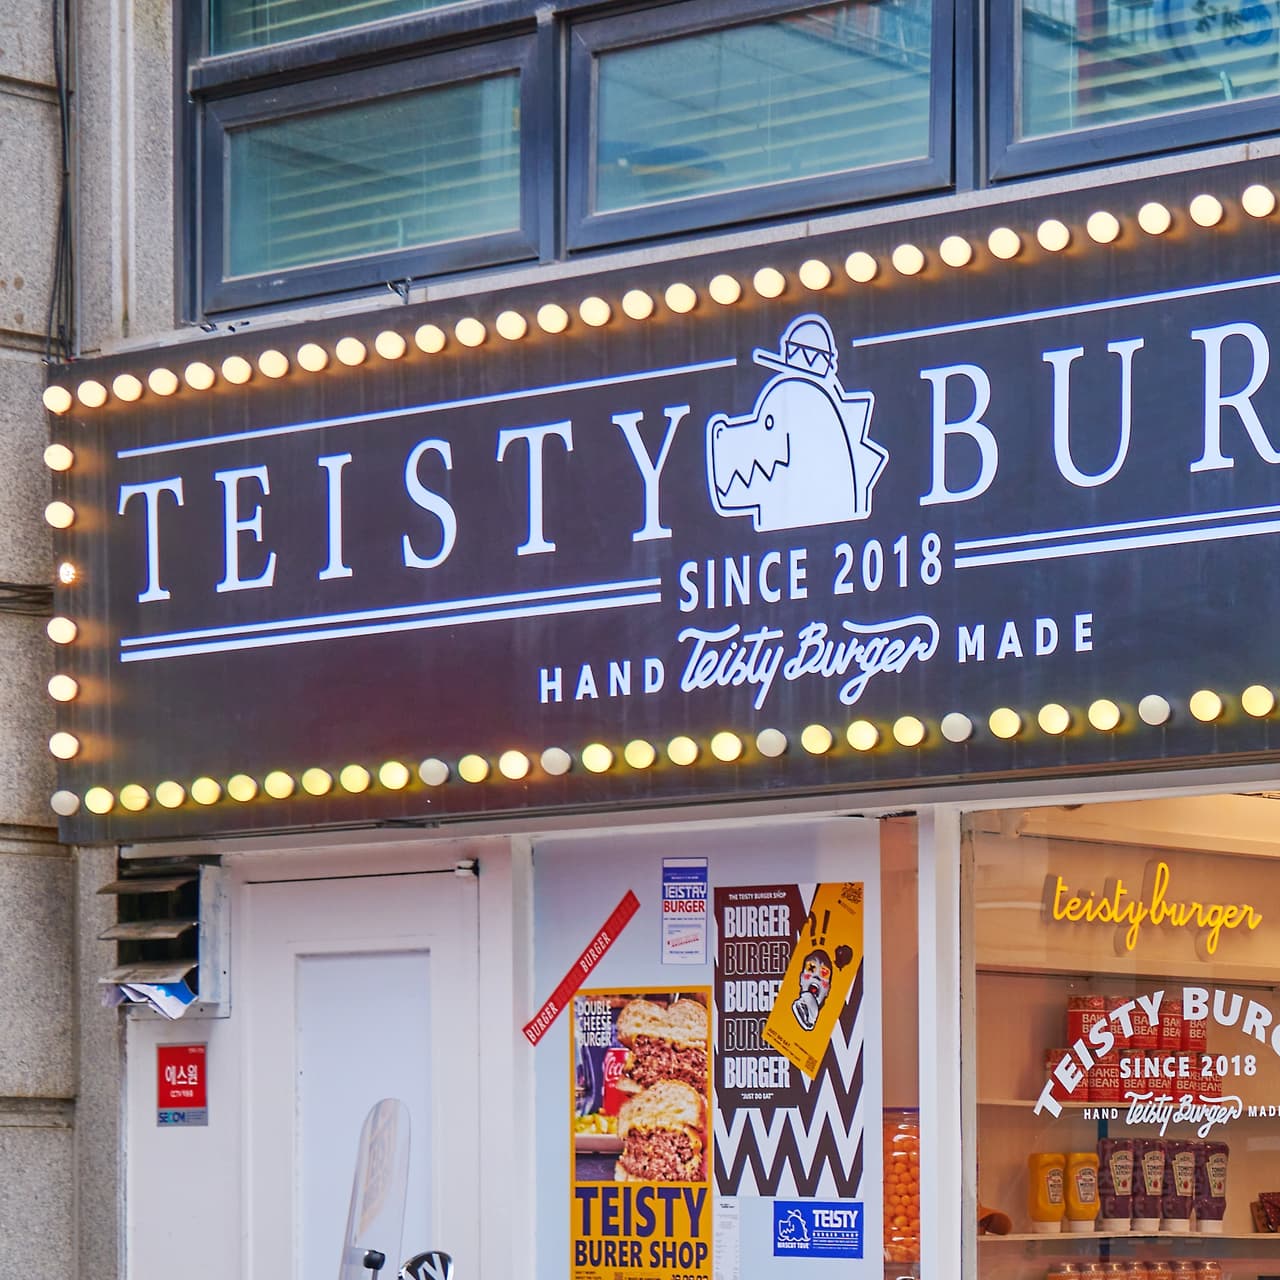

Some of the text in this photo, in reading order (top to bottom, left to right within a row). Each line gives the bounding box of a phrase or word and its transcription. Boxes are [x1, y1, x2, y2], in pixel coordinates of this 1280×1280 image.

[117, 404, 692, 604] TEISTY
[679, 533, 944, 613] SINCE 2018
[541, 613, 1094, 711] HAND Teisty Burger MADE
[664, 900, 706, 913] BURGER
[724, 905, 791, 938] BURGER
[580, 930, 612, 974] BURGER
[724, 941, 791, 975] BURGER
[577, 1001, 612, 1016] DOUBLE
[724, 980, 784, 1013] BURGE
[525, 1001, 559, 1043] BURGER
[578, 1016, 612, 1031] CHEESE
[578, 1031, 612, 1047] BURGER
[1032, 989, 1166, 1120] TEISTY
[165, 1064, 198, 1086] 에스원
[724, 1056, 791, 1089] BURGER
[1120, 1055, 1258, 1079] SINCE 2018
[1084, 1108, 1119, 1120] HAND
[1123, 1091, 1174, 1136] Teisty
[1173, 1094, 1243, 1139] Burger
[575, 1186, 708, 1238] TEISTY
[812, 1209, 858, 1228] TEISTY
[575, 1240, 708, 1269] BURER SHOP
